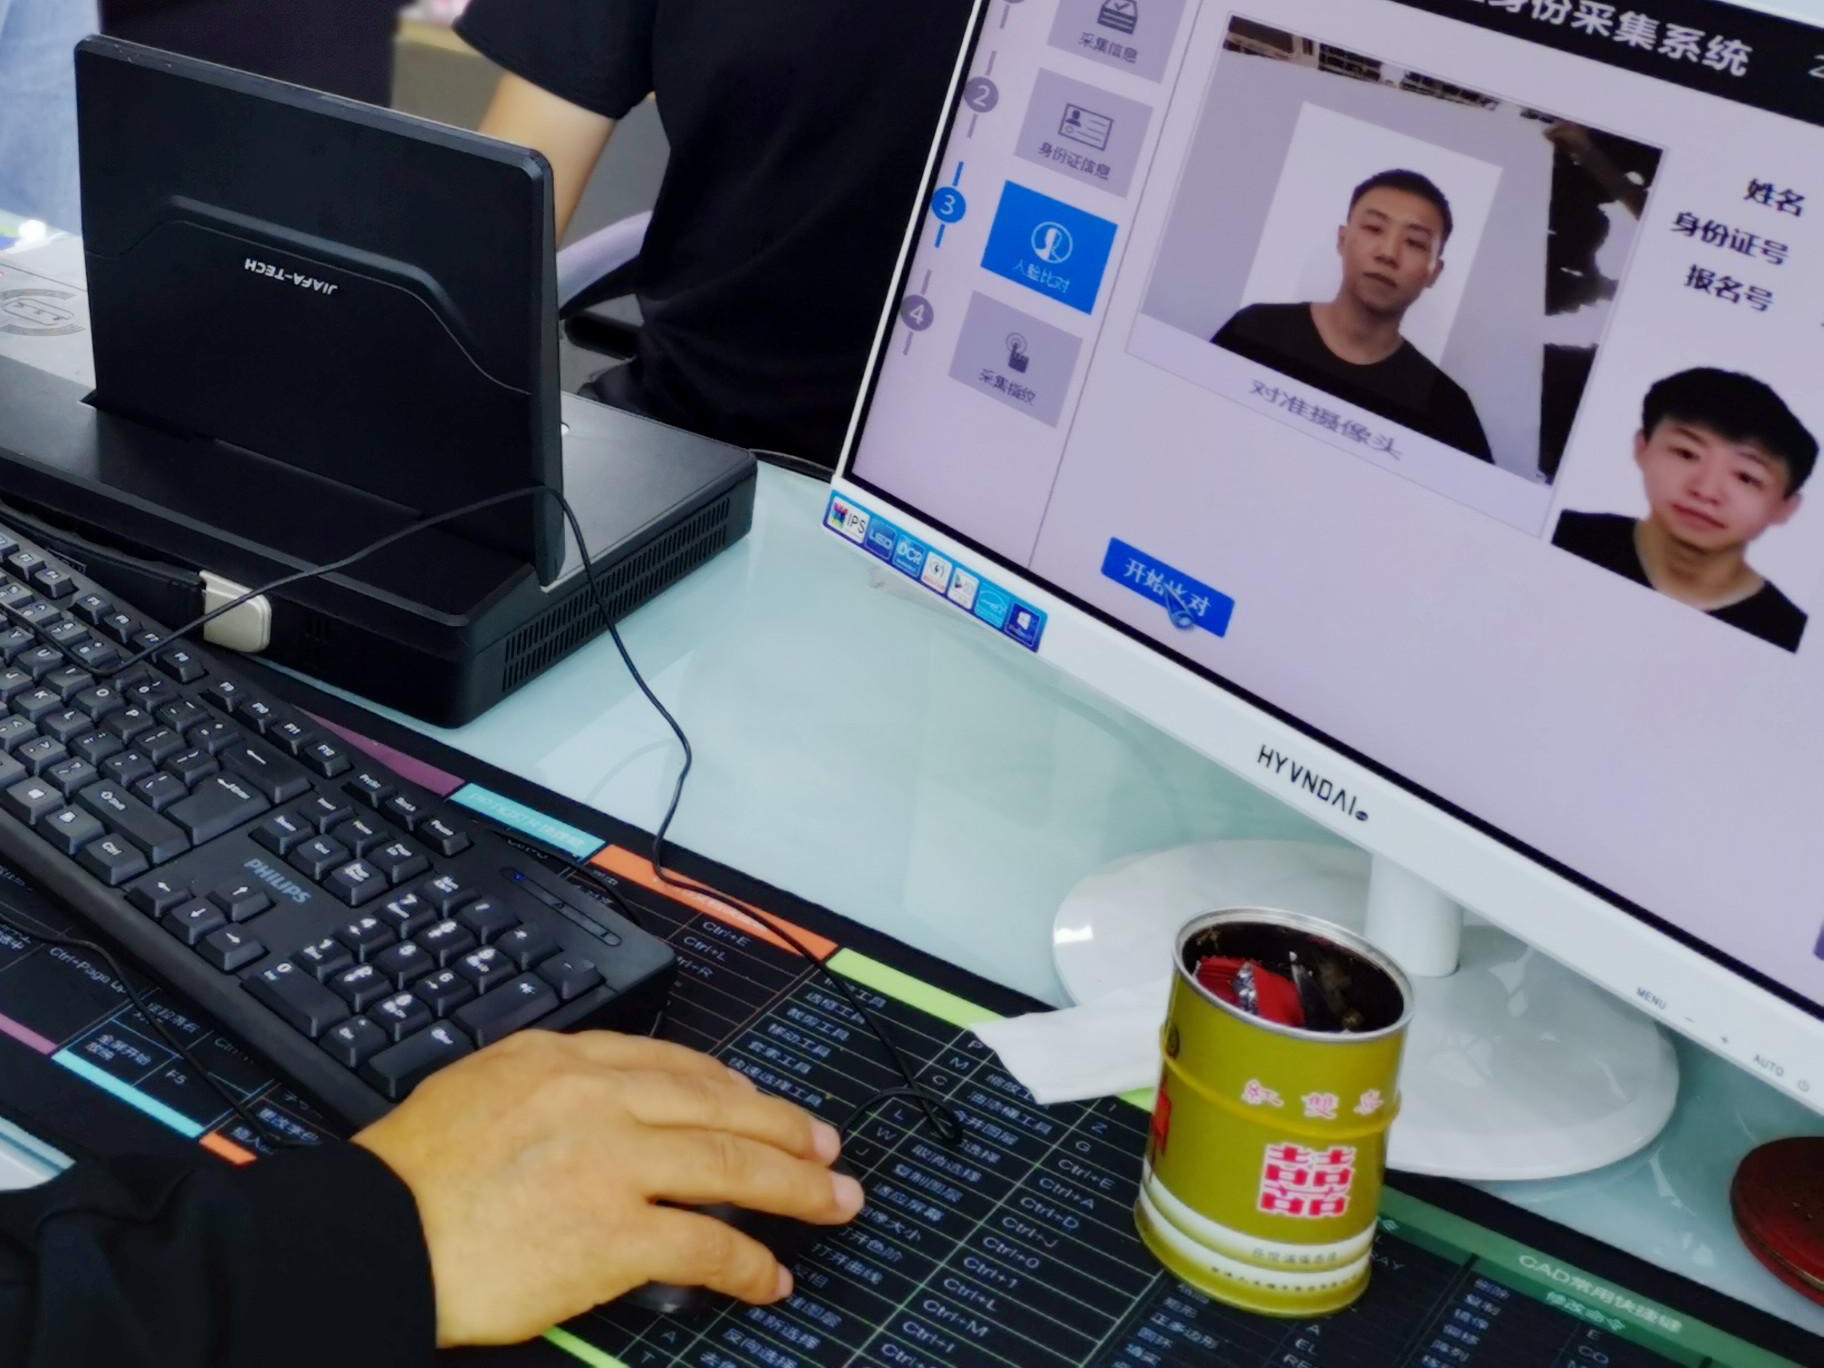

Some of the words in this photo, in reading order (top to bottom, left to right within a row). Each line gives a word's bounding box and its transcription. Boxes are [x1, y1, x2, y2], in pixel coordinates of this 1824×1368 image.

[1077, 31, 1139, 64] 采集信息
[972, 84, 990, 107] 2
[1037, 141, 1111, 181] 身份证信息
[939, 193, 957, 216] 3
[1743, 177, 1806, 218] 姓名
[1670, 211, 1790, 266] 身份证号
[243, 257, 339, 296] JIAFA-TECH
[1011, 258, 1071, 294] 人脸比对
[1683, 263, 1774, 313] 报名号
[909, 304, 925, 326] 4
[977, 368, 1037, 406] 采集指纹
[1248, 378, 1404, 462] 对准摄像头
[847, 512, 867, 535] IPS
[1123, 557, 1211, 618] 开始比对
[244, 857, 312, 904] PHILIPS
[682, 934, 727, 962] Ctrl+L
[701, 919, 752, 950] Ctrl+E
[49, 946, 111, 984] Ctrl+Page
[675, 954, 715, 979] trl+R
[1636, 986, 1668, 1011] MENU
[767, 1023, 832, 1059] 移动工具
[164, 1069, 189, 1086] F5
[932, 1074, 949, 1086] C
[949, 1056, 970, 1070] M
[1752, 1053, 1785, 1078] AUTO
[984, 1073, 1037, 1103] 缩放工
[876, 1126, 897, 1141] W
[1091, 1121, 1108, 1135] Z
[911, 1142, 983, 1183] 取消选择
[1075, 1140, 1092, 1153] G
[892, 1162, 965, 1204] 复制图层
[1057, 1157, 1115, 1191] Ctrl+E
[872, 1182, 945, 1223] 适应屏幕
[1039, 1176, 1096, 1210] Ctrl+A
[1020, 1196, 1080, 1230] Ctrl+D
[1001, 1215, 1059, 1249] Ctrl+J
[812, 1242, 885, 1285] 打开曲线
[962, 1256, 1019, 1289] Ctrl+1
[943, 1277, 998, 1313] Ctrl+L
[1517, 1254, 1684, 1334] CAD常用快捷键
[922, 1298, 990, 1338] Ctrl+M
[1545, 1291, 1626, 1333] 修改命令
[901, 1320, 958, 1355] Ctrl+I
[1151, 1312, 1219, 1351] 正多边形
[1295, 1336, 1319, 1356] EL
[1577, 1344, 1610, 1365] CO
